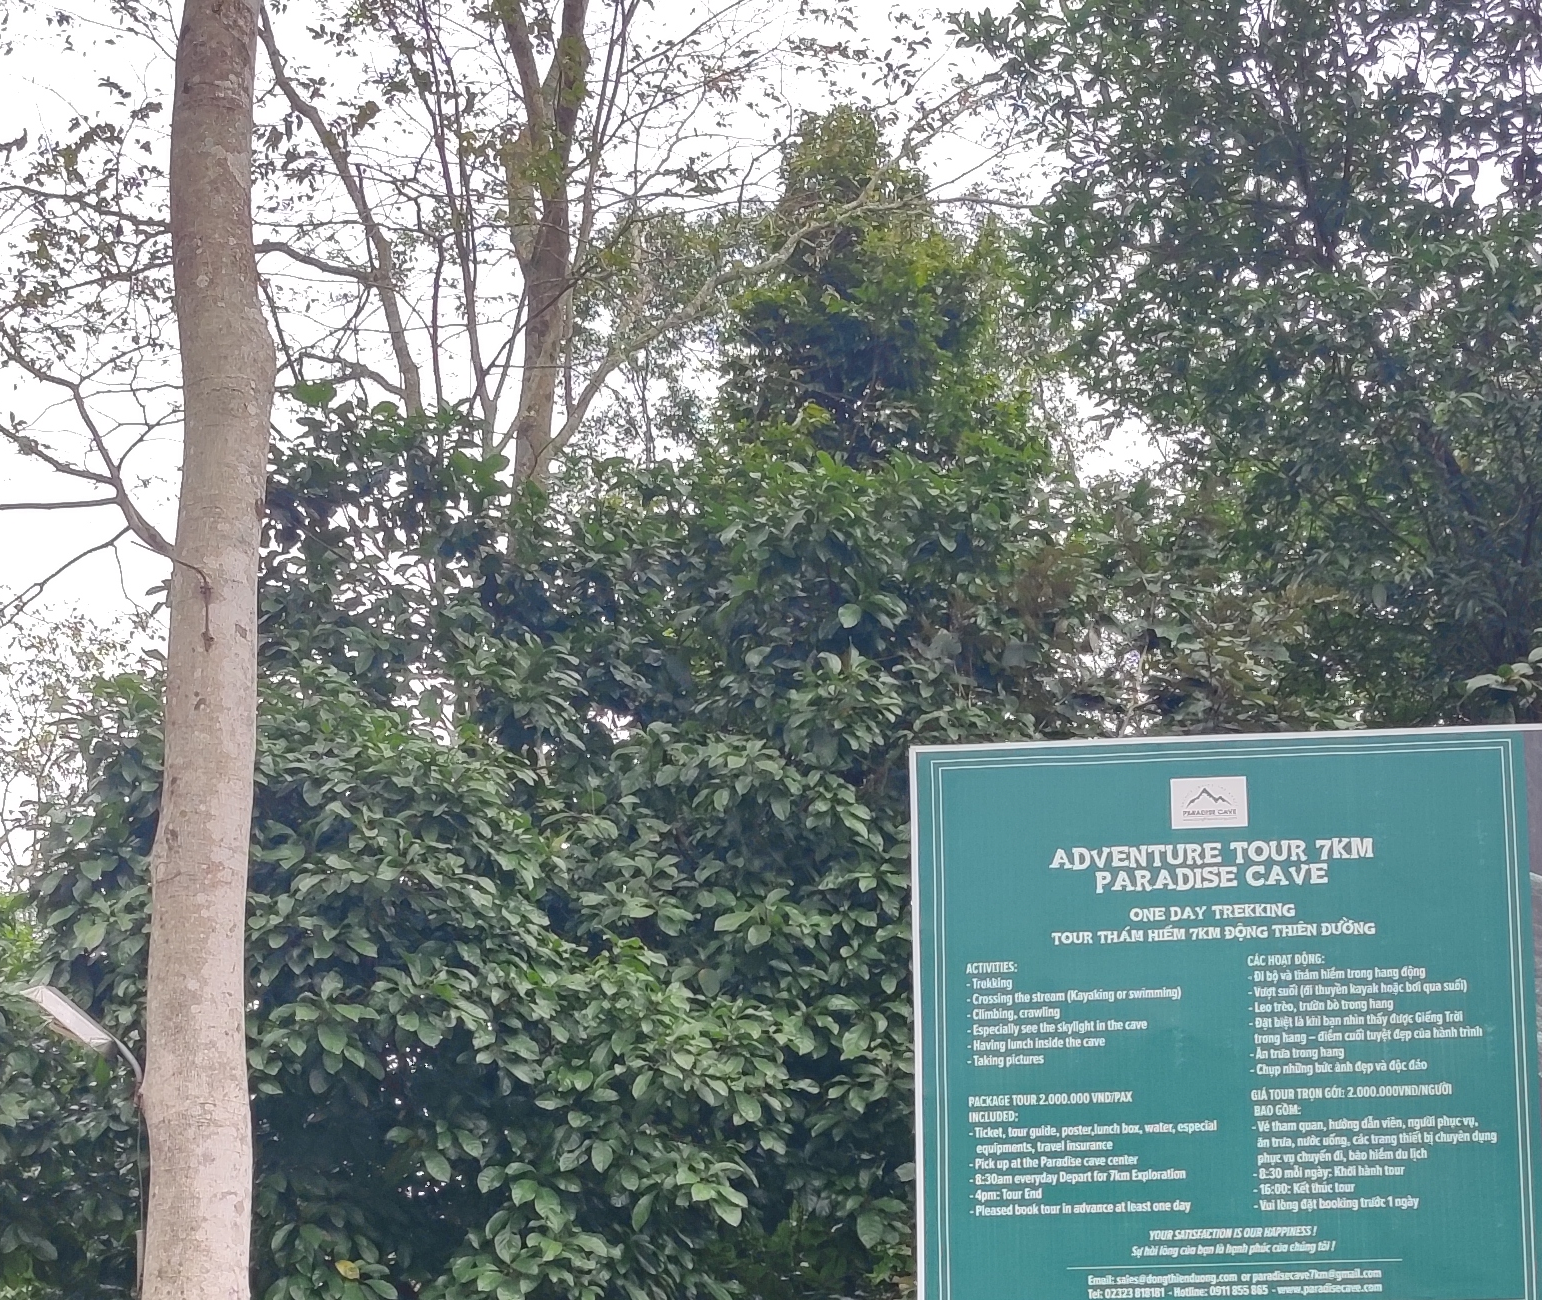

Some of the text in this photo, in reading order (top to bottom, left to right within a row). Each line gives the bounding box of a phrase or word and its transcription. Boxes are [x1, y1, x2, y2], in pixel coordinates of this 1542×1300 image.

[1049, 837, 1373, 870] ADVENTURE TOUR 7KM
[1095, 863, 1328, 893] PARADISE CAVE
[1130, 903, 1295, 921] ONE DAY TREKKING
[966, 961, 1017, 973] ACTIVITIES:
[972, 986, 1181, 1006] Crossing the stream (Kayaking or swimming)
[1019, 1006, 1060, 1019] crawling
[973, 1019, 1147, 1037] Especially see the skylight in the cave
[973, 1036, 1105, 1052] Having lunch inside the cave
[973, 1053, 1044, 1068] Taking pictures
[969, 1111, 1018, 1122] INCLUDED:
[974, 1127, 1006, 1138] Ticket,
[1008, 1127, 1028, 1137] tour
[1029, 1125, 1059, 1139] guide,
[1122, 1123, 1142, 1134] box,
[1177, 1120, 1217, 1133] especial
[975, 1154, 1138, 1171] Pick up at the Paradise cave center
[1014, 1172, 1057, 1185] everyday
[1059, 1171, 1092, 1184] Depart
[1093, 1170, 1107, 1181] for
[1108, 1170, 1130, 1180] 7km
[1132, 1168, 1186, 1182] Exploration
[975, 1188, 1042, 1202] 4pm: Tour End
[976, 1200, 1191, 1216] Pleased book tour in advance at least one day
